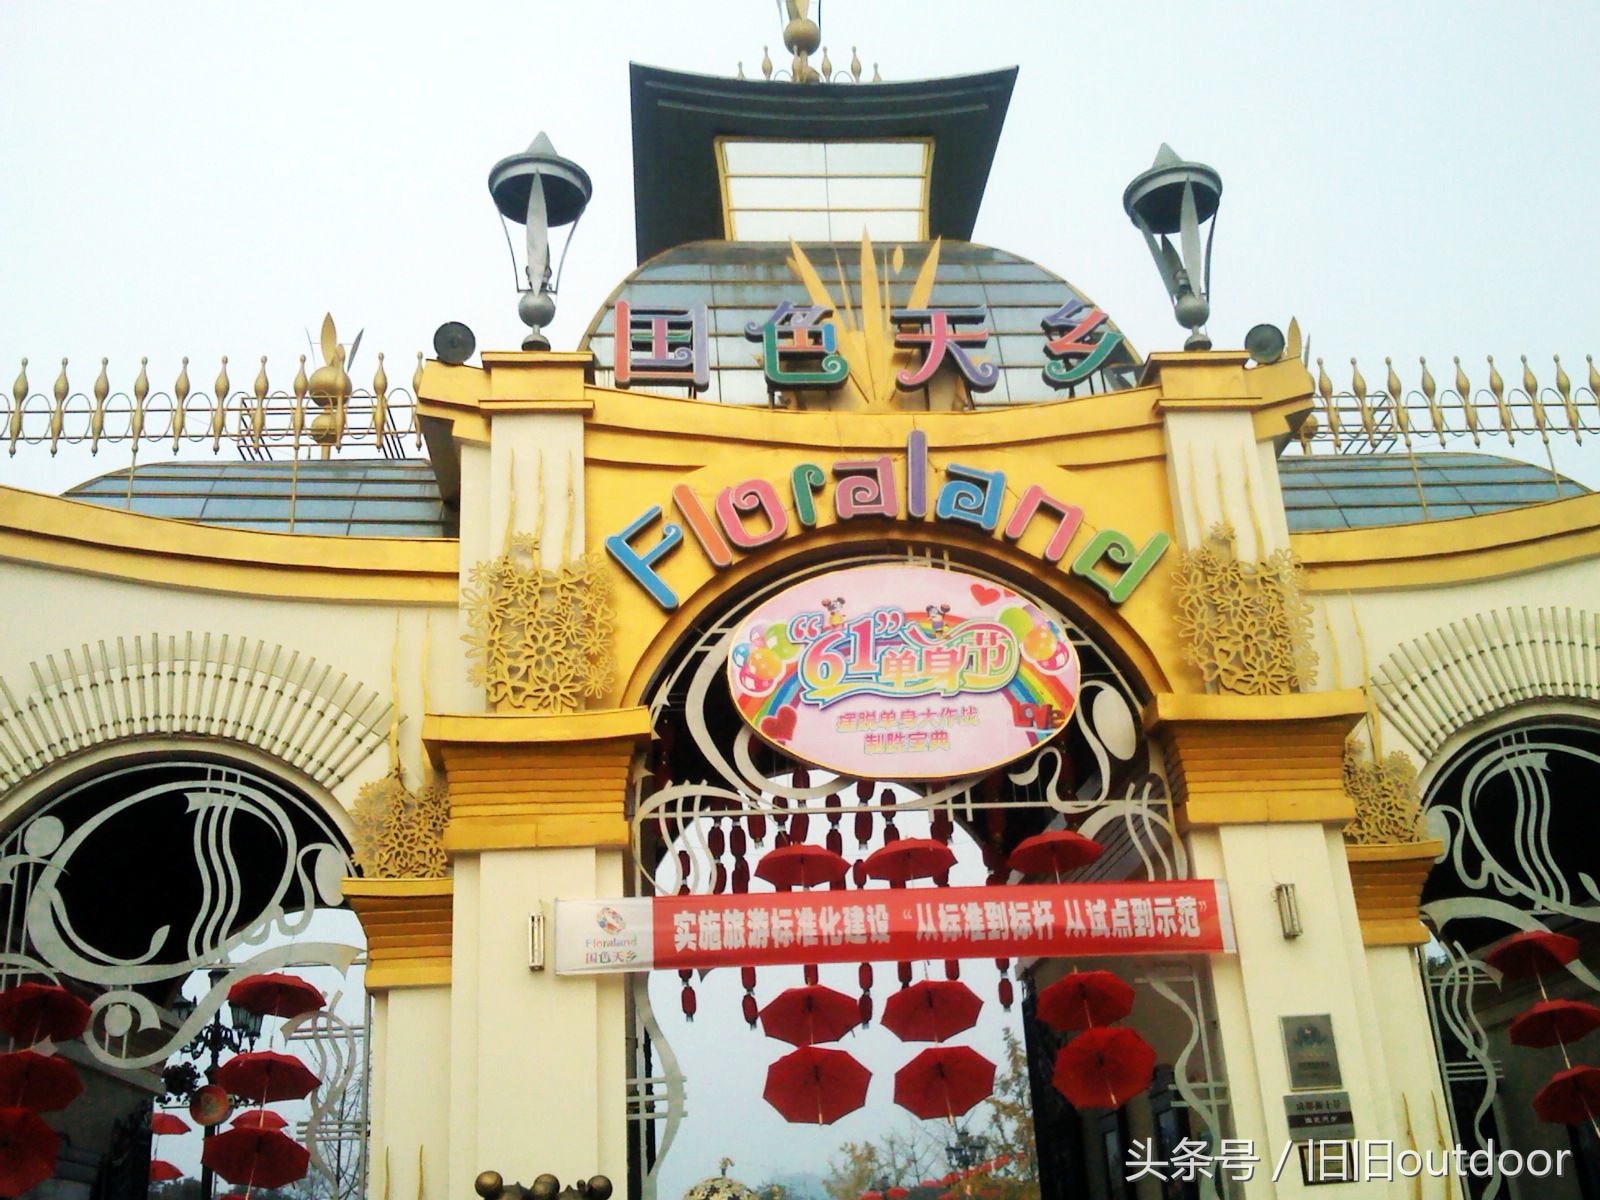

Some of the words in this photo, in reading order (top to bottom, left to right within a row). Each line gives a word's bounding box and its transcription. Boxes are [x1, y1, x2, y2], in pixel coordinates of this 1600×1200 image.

[614, 299, 1126, 394] 国色天乡
[604, 429, 1170, 610] Floraland
[585, 950, 637, 964] 国色天乡
[673, 903, 890, 952] 实施旅游标准化建设
